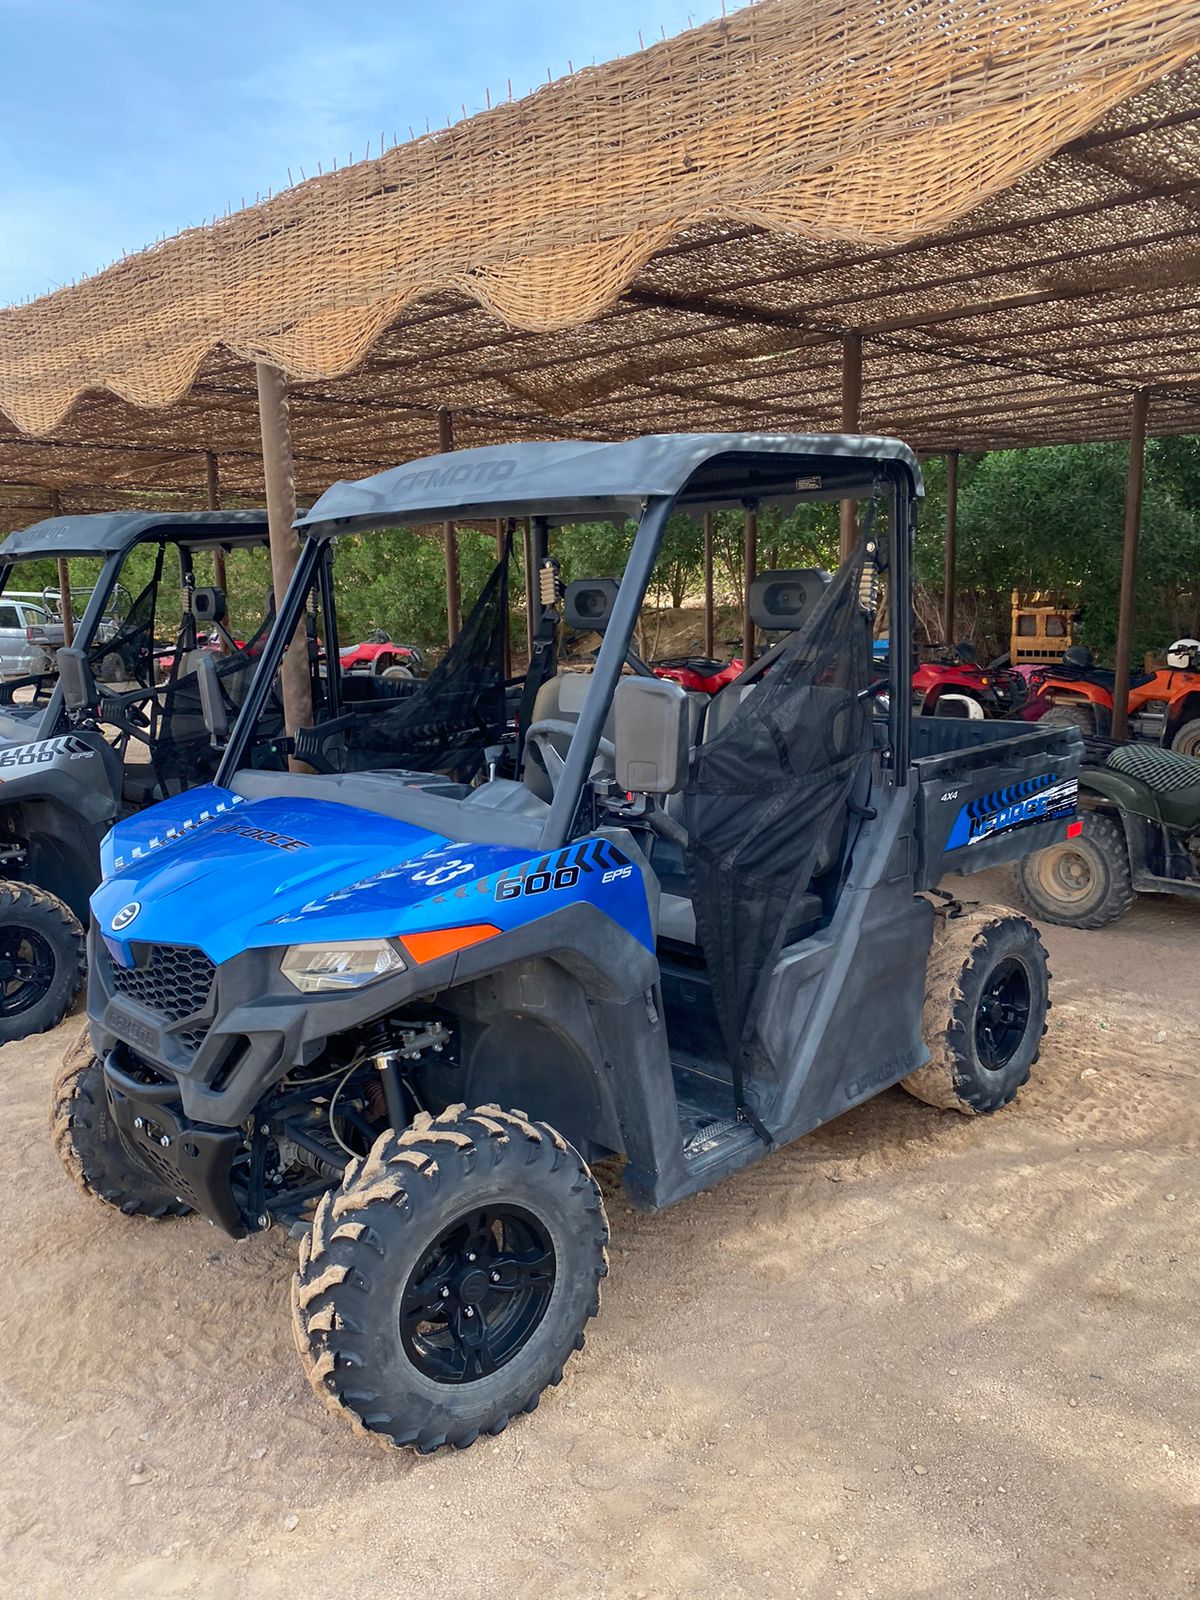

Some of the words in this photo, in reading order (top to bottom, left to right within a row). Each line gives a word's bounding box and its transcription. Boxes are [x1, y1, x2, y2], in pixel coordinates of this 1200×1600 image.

[392, 460, 517, 494] CFMOTO
[0, 751, 55, 768] 600
[70, 751, 95, 760] EPS
[940, 790, 959, 802] 4X4
[411, 859, 475, 886] 33
[494, 866, 581, 902] 600
[601, 865, 633, 884] EPS
